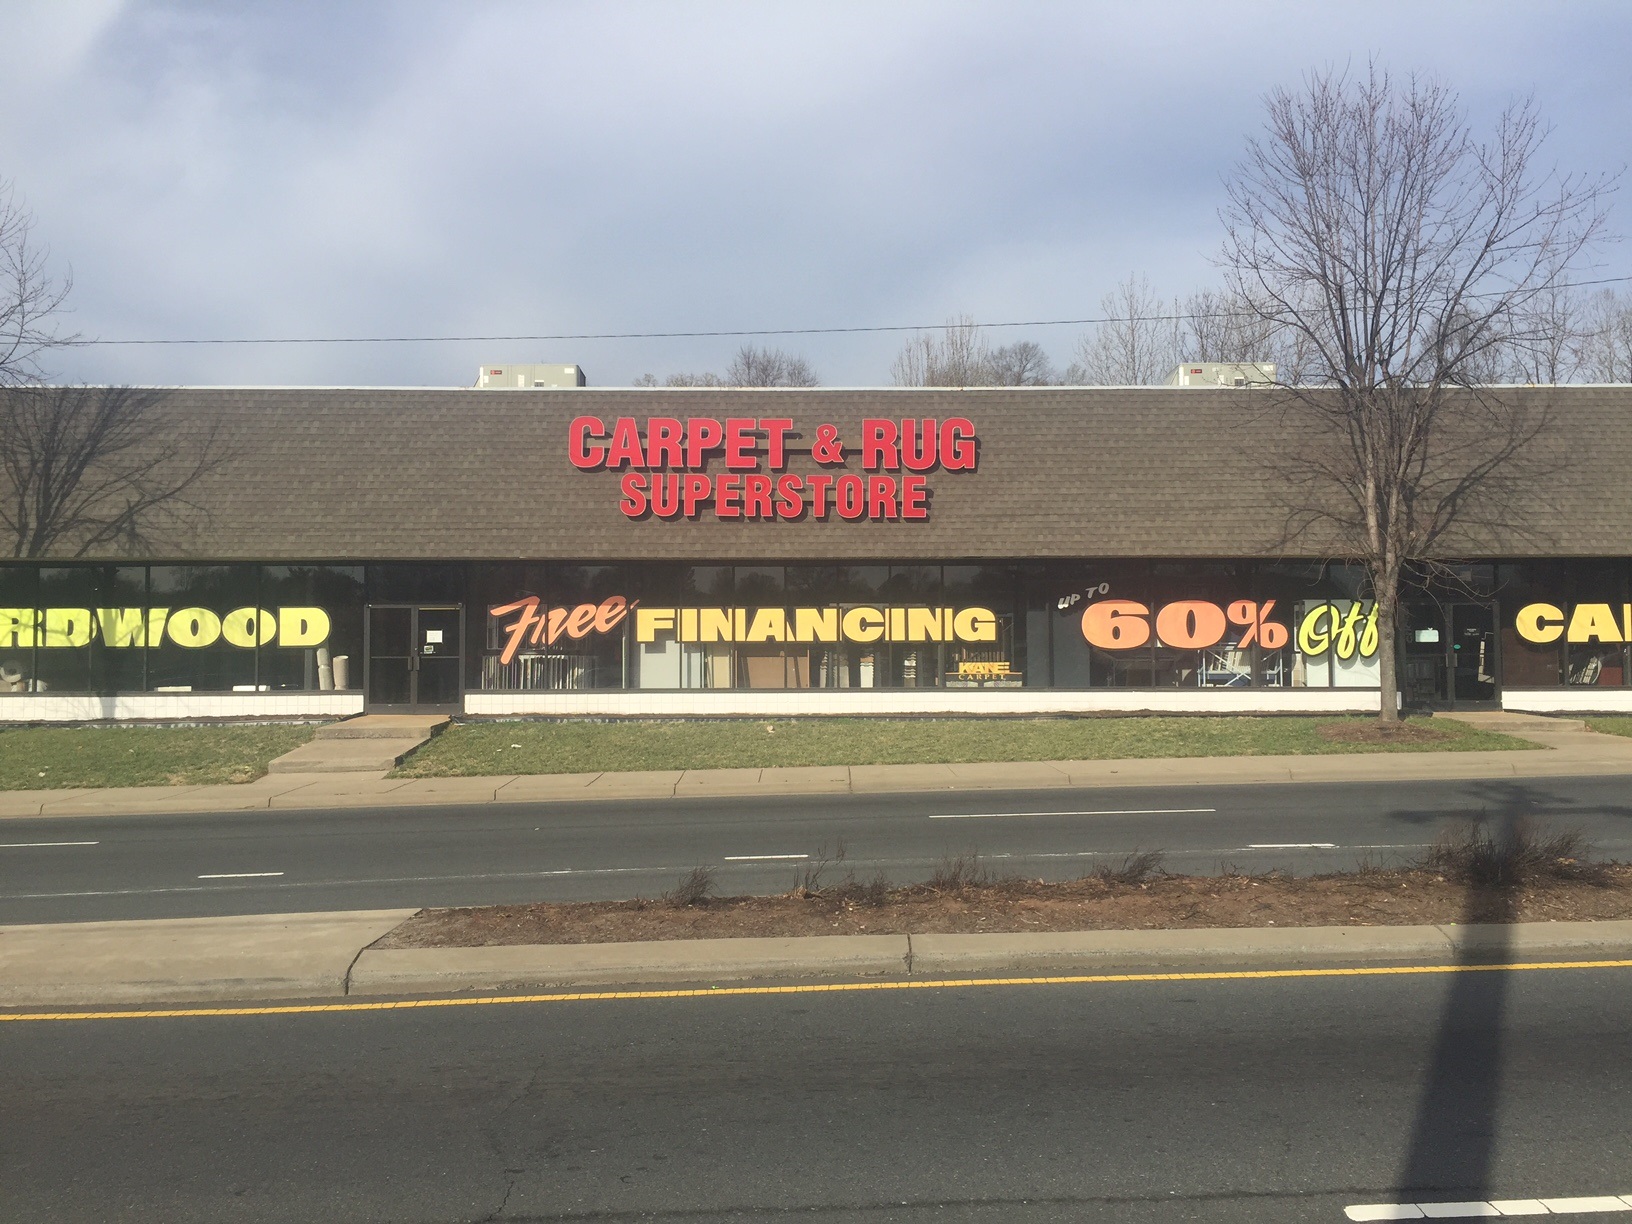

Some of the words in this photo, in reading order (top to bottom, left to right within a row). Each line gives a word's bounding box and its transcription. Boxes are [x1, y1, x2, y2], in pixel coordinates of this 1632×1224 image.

[569, 416, 793, 468] CARPET
[812, 424, 844, 463] &
[862, 417, 975, 470] RUG
[620, 473, 927, 518] SUPERSTORE
[1058, 594, 1080, 609] UP
[1086, 583, 1109, 598] TO
[0, 607, 330, 647] RDWOOD
[490, 595, 639, 665] Free
[637, 607, 996, 642] FINANCING
[1081, 600, 1289, 649] 60%
[1299, 602, 1379, 659] Off
[1516, 603, 1632, 643] CA
[959, 662, 1010, 674] KANE
